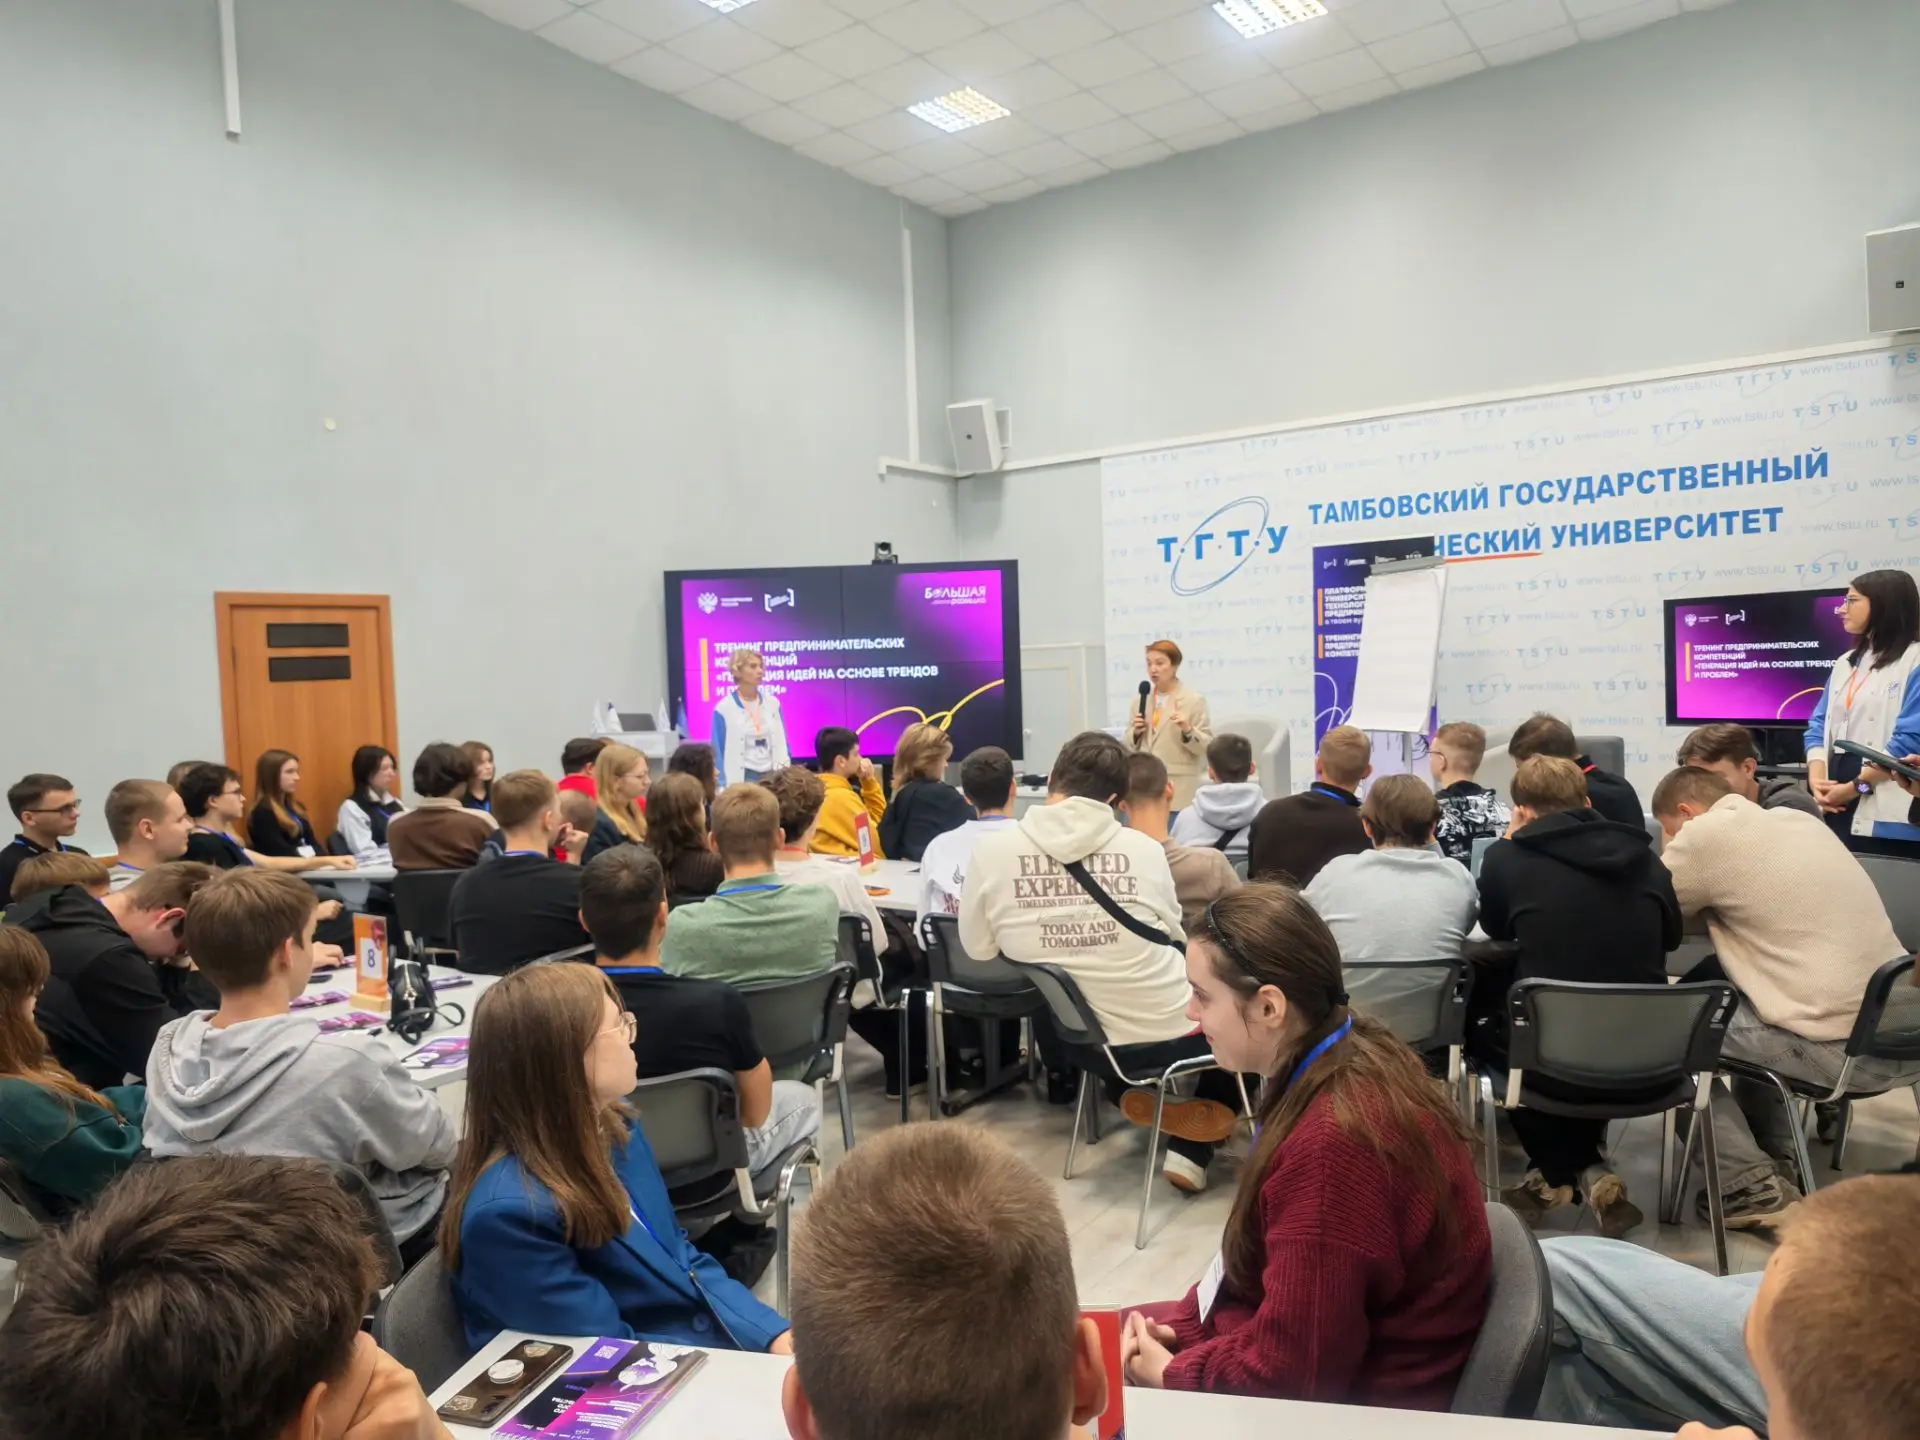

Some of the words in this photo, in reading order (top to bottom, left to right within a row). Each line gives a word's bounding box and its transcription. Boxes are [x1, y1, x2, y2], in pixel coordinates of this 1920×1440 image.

[1888, 352, 1917, 366] TS
[1887, 434, 1917, 448] TS
[1308, 481, 1489, 525] ТАМБОВСКИЙ
[1499, 446, 1829, 505] ГОСУДАРСТВЕННЫЙ
[1888, 515, 1918, 528] TS
[1434, 523, 1541, 557] ЧЕСКИЙ
[1551, 506, 1784, 548] УНИВЕРСИТЕТ
[764, 638, 905, 653] ПРЕДПРИНИМАТЕЛЬСКИХ
[1693, 644, 1723, 652] ТРЕНИНГ
[1724, 641, 1820, 652] ПРЕДПРИНИМАТЕЛЬСКИХ
[1693, 651, 1746, 661] КОМПЕТЕНЦИЙ
[1738, 659, 1758, 670] ИДЕЙ
[1759, 660, 1771, 669] НА
[1771, 660, 1805, 668] ОСНОВЕ
[1805, 659, 1837, 668] ТРЕНДО
[786, 667, 817, 682] ИДЕЙ
[819, 669, 836, 680] НА
[837, 667, 886, 679] ОСНОВЕ
[886, 665, 939, 679] ТРЕНДОВ
[1018, 853, 1131, 877] ELETED
[1013, 875, 1139, 899] EXPERNCE
[1016, 898, 1057, 909] TIMELESS
[1040, 923, 1086, 936] TODAY
[1088, 920, 1117, 933] AND
[1039, 932, 1120, 949] TOMORROW
[367, 949, 376, 969] 8
